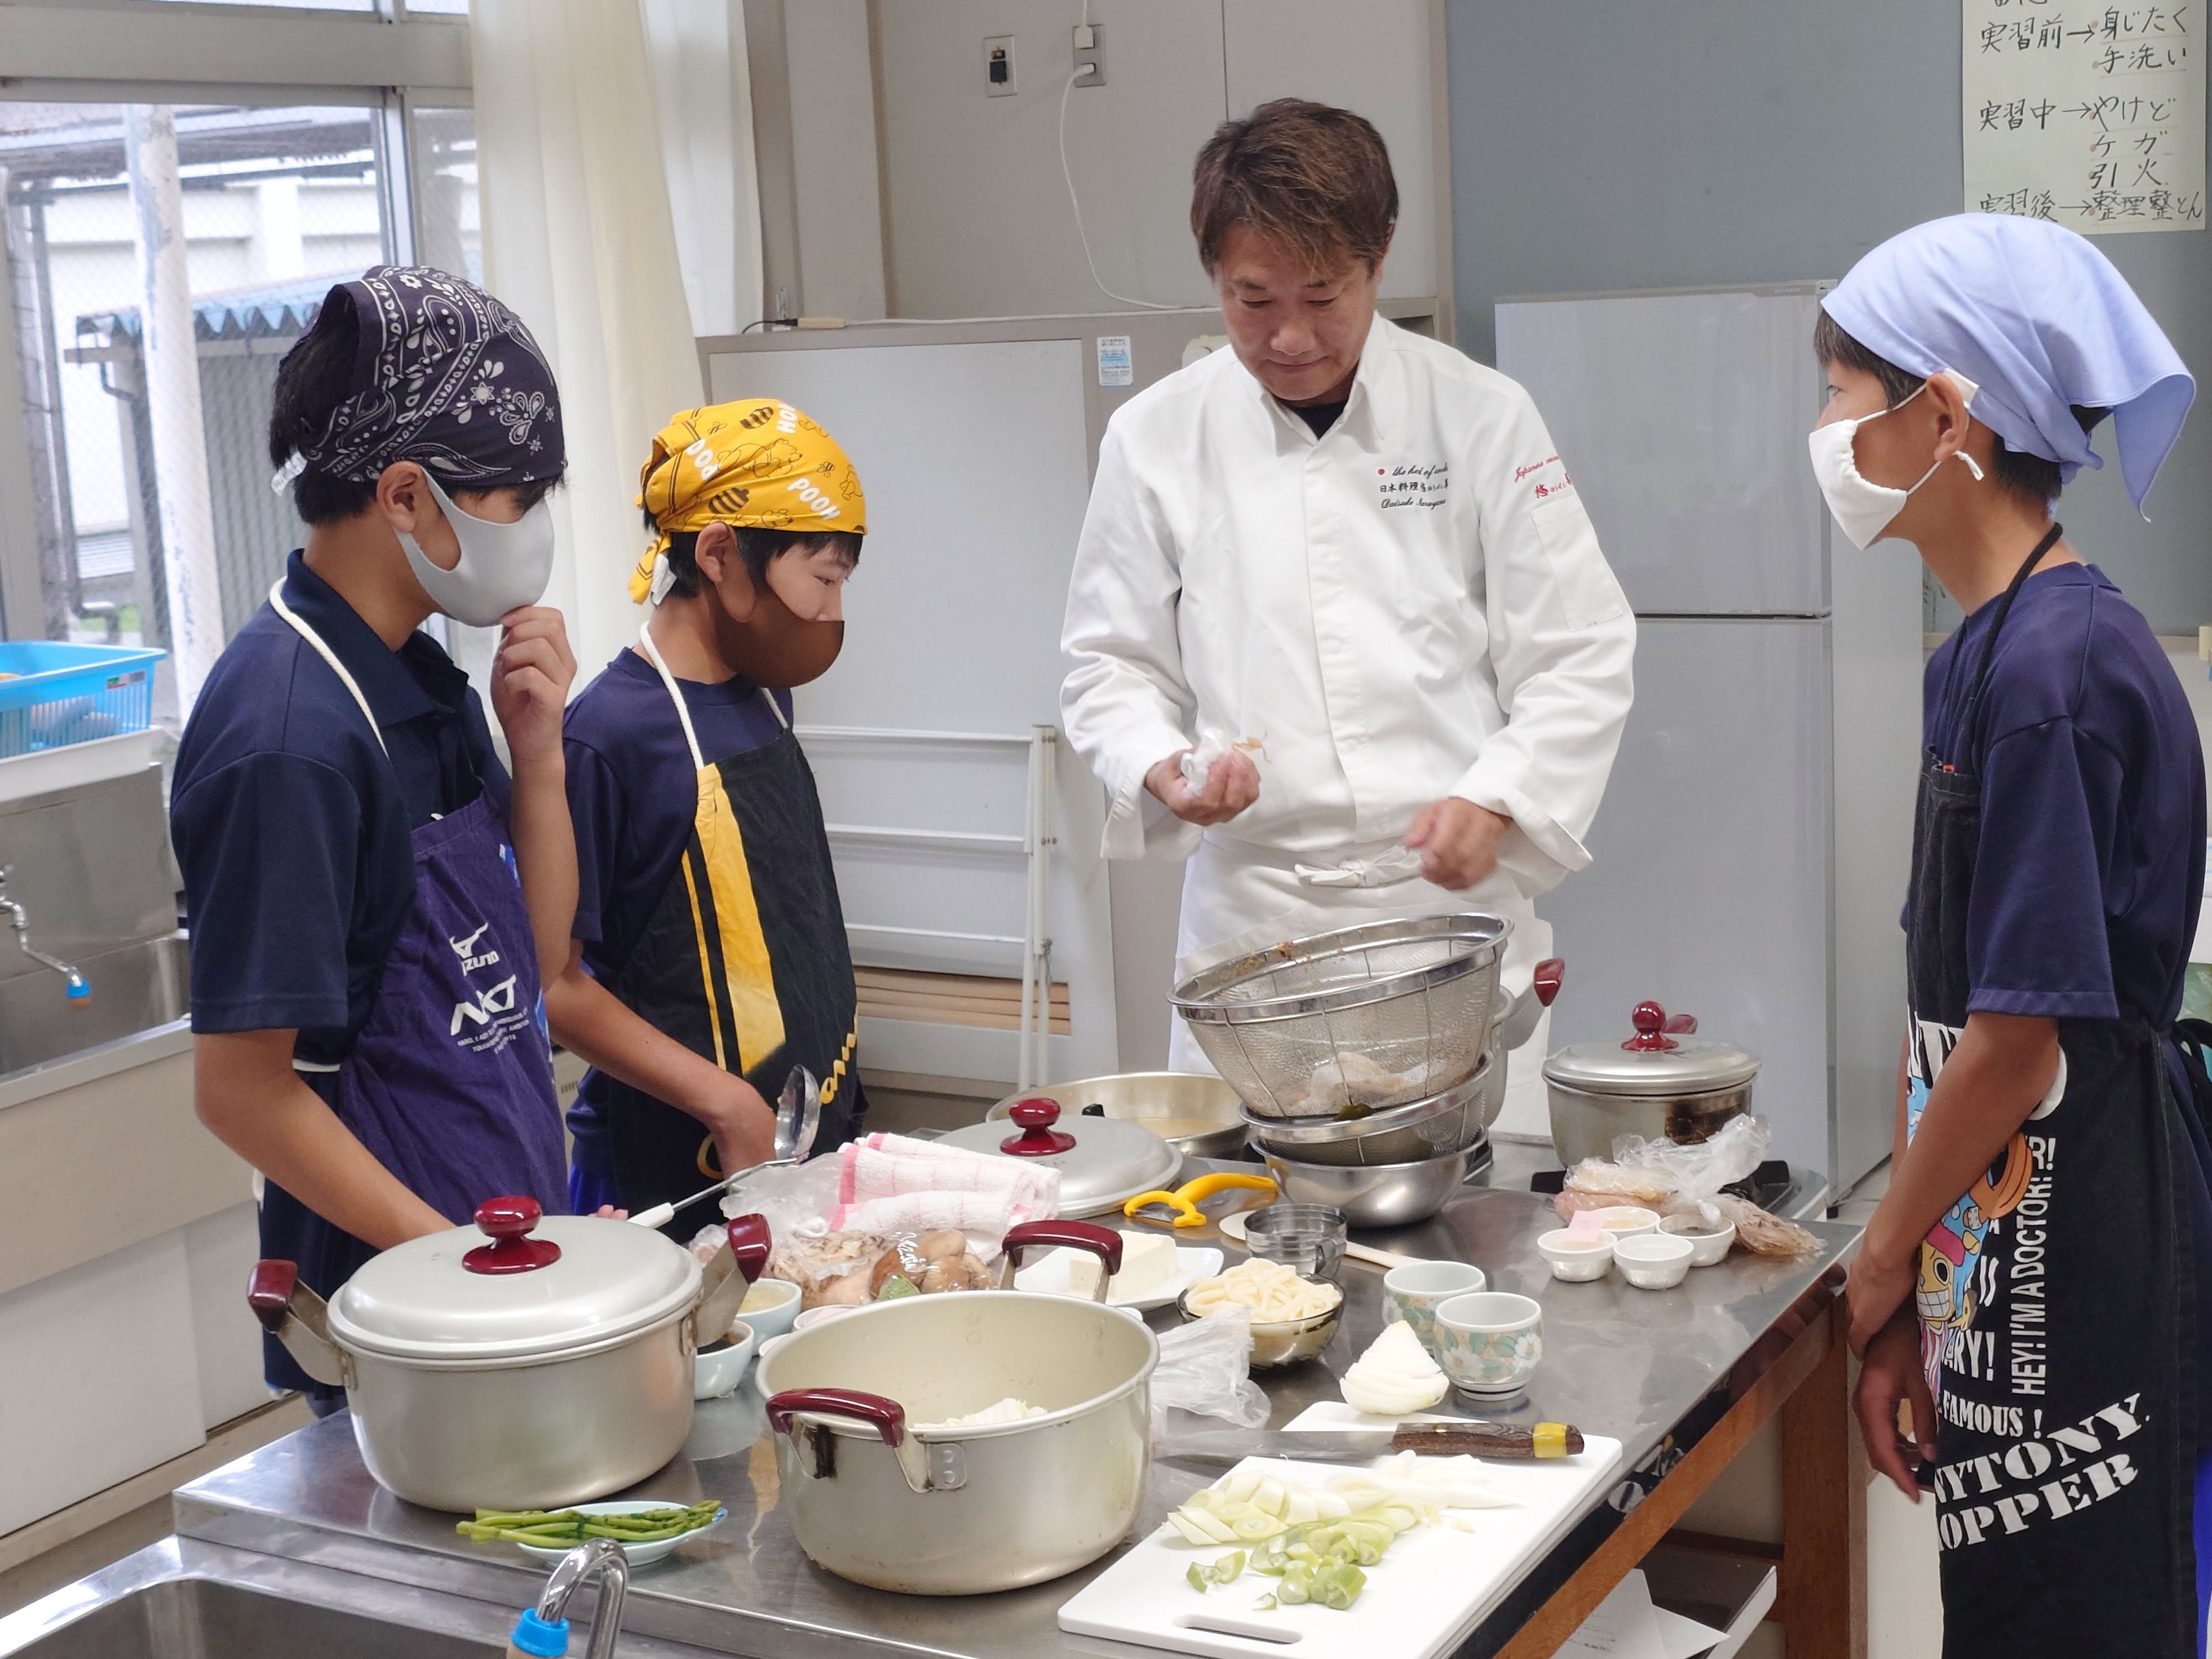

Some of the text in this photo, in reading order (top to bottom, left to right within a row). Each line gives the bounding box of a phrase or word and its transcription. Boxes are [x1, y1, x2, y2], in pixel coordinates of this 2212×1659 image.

[1981, 6, 2187, 54] 実習前 身じたく
[2099, 43, 2187, 74] 手洗い
[1980, 96, 2176, 132] 実習中 やけど
[2096, 131, 2167, 158] ケガ
[2091, 159, 2162, 189] 引火
[2091, 189, 2203, 221] 整理整とん
[787, 478, 841, 520] POOH
[2010, 1176, 2053, 1395] HEY! I'M A DOCTOR!
[1943, 1389, 2024, 1438] FAMOUS
[1938, 1453, 2139, 1551] OPPER
